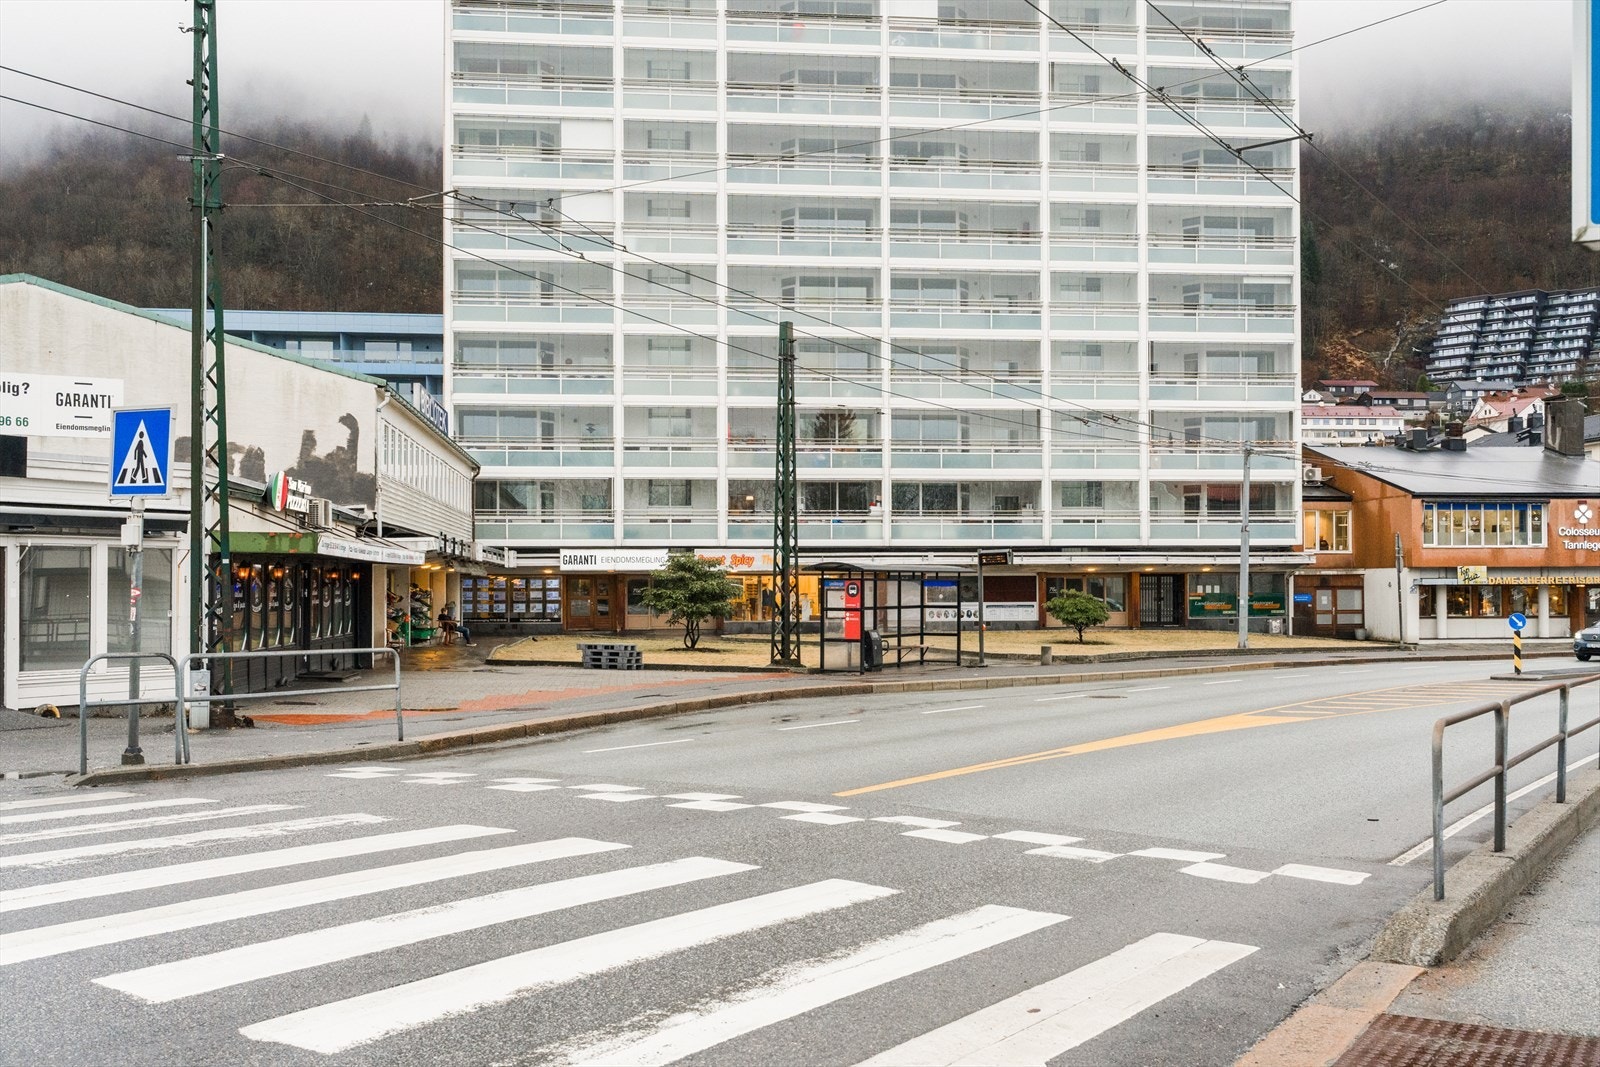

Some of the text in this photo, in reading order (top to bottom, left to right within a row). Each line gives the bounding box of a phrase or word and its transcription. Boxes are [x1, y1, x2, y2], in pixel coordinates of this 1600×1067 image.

[0, 381, 30, 397] lig?
[56, 392, 111, 409] GARANTI
[15, 417, 29, 427] 66
[56, 423, 111, 432] Eiendomsmeglin
[562, 554, 665, 565] GARANTI EIENDOMSMEGLING
[730, 554, 754, 567] Spicy
[1488, 576, 1517, 585] DAME
